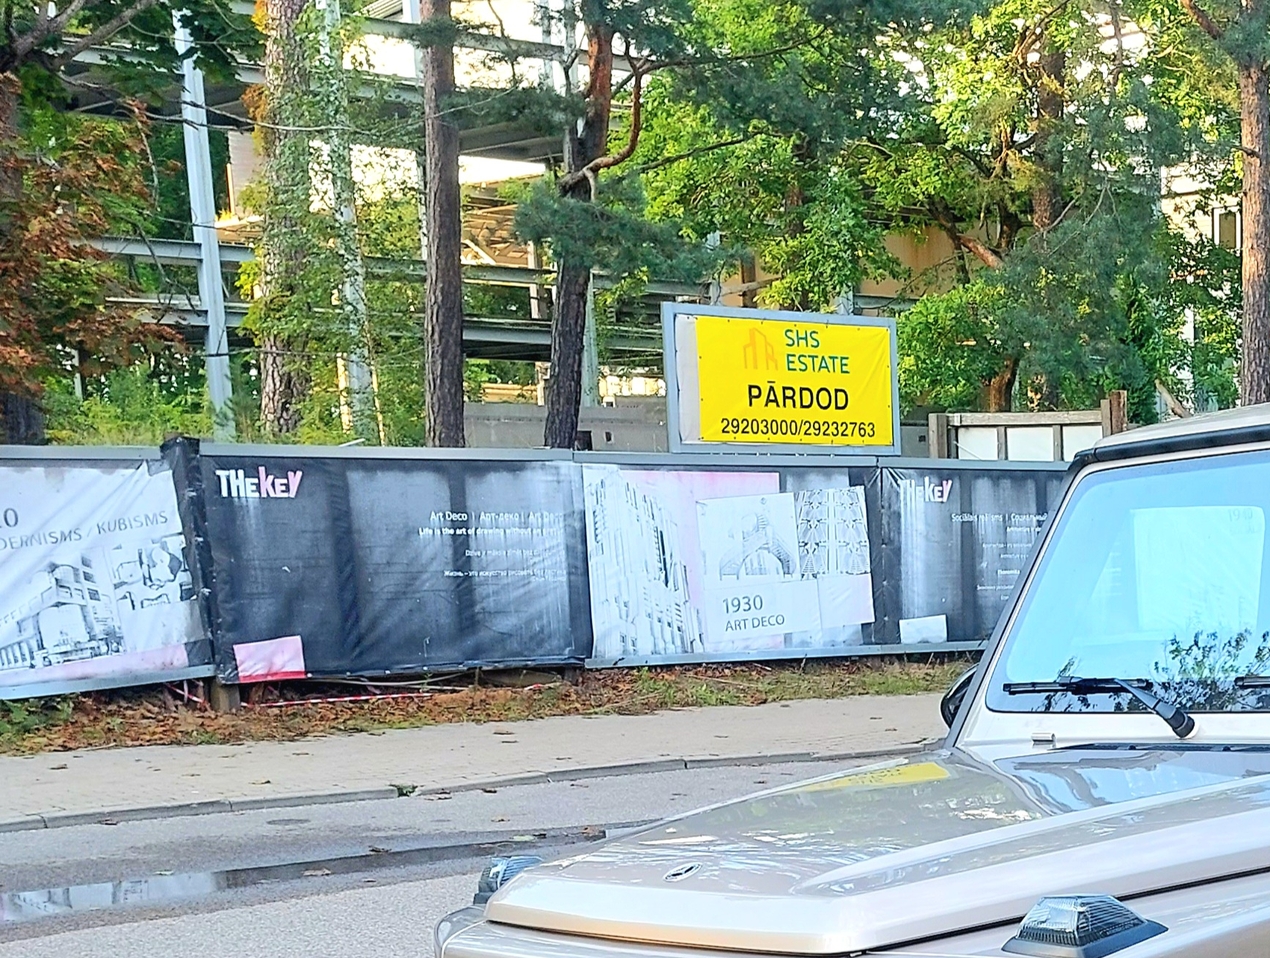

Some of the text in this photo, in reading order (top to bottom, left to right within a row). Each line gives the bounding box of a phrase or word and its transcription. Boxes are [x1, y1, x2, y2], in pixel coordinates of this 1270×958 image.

[784, 329, 820, 348] SHS
[786, 354, 850, 374] ESTATE
[748, 380, 849, 410] PĀRDOD
[721, 418, 875, 437] 29203000/29232763
[96, 511, 168, 535] KUBISMS
[446, 511, 468, 521] Deco
[722, 594, 763, 614] 1930
[725, 614, 785, 632] ART DECO
